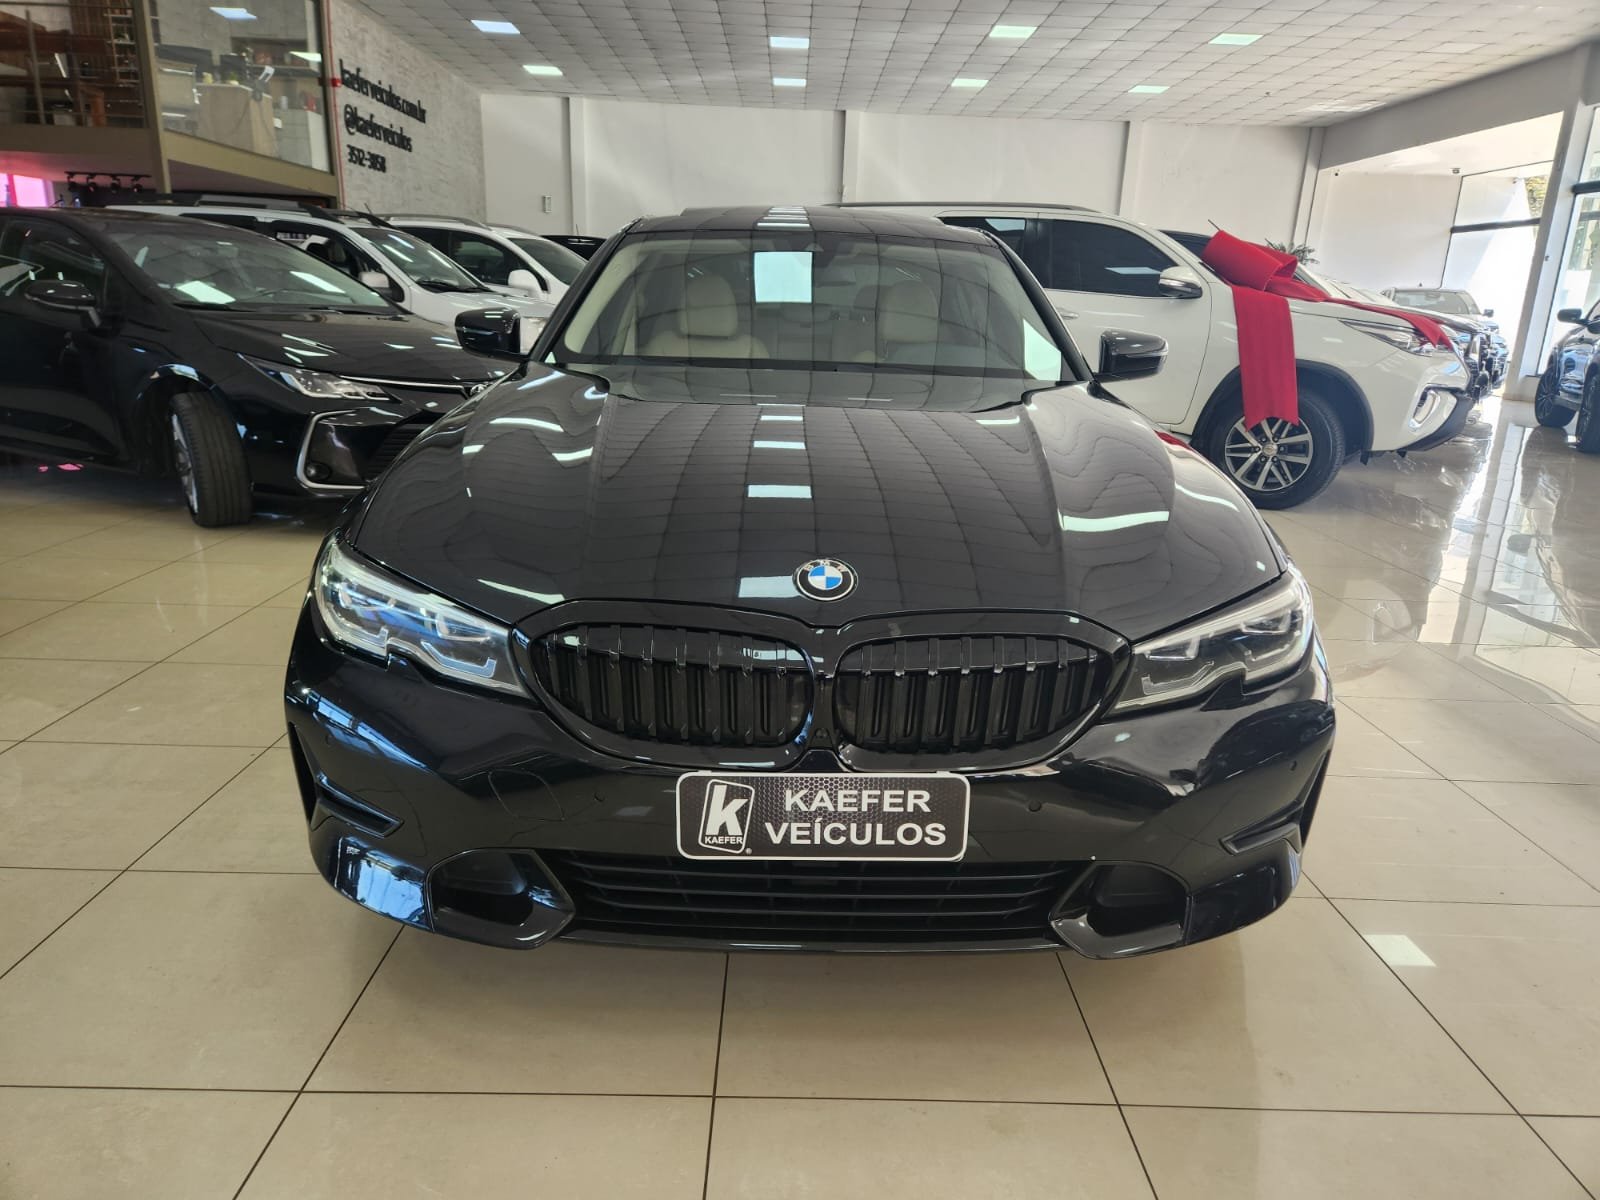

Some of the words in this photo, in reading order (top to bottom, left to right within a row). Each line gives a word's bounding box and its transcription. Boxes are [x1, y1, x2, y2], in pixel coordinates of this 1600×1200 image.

[803, 558, 848, 572] BMW
[785, 790, 932, 813] KAEFER
[704, 836, 743, 845] KAEFER
[765, 818, 946, 846] VEÍCULOS
